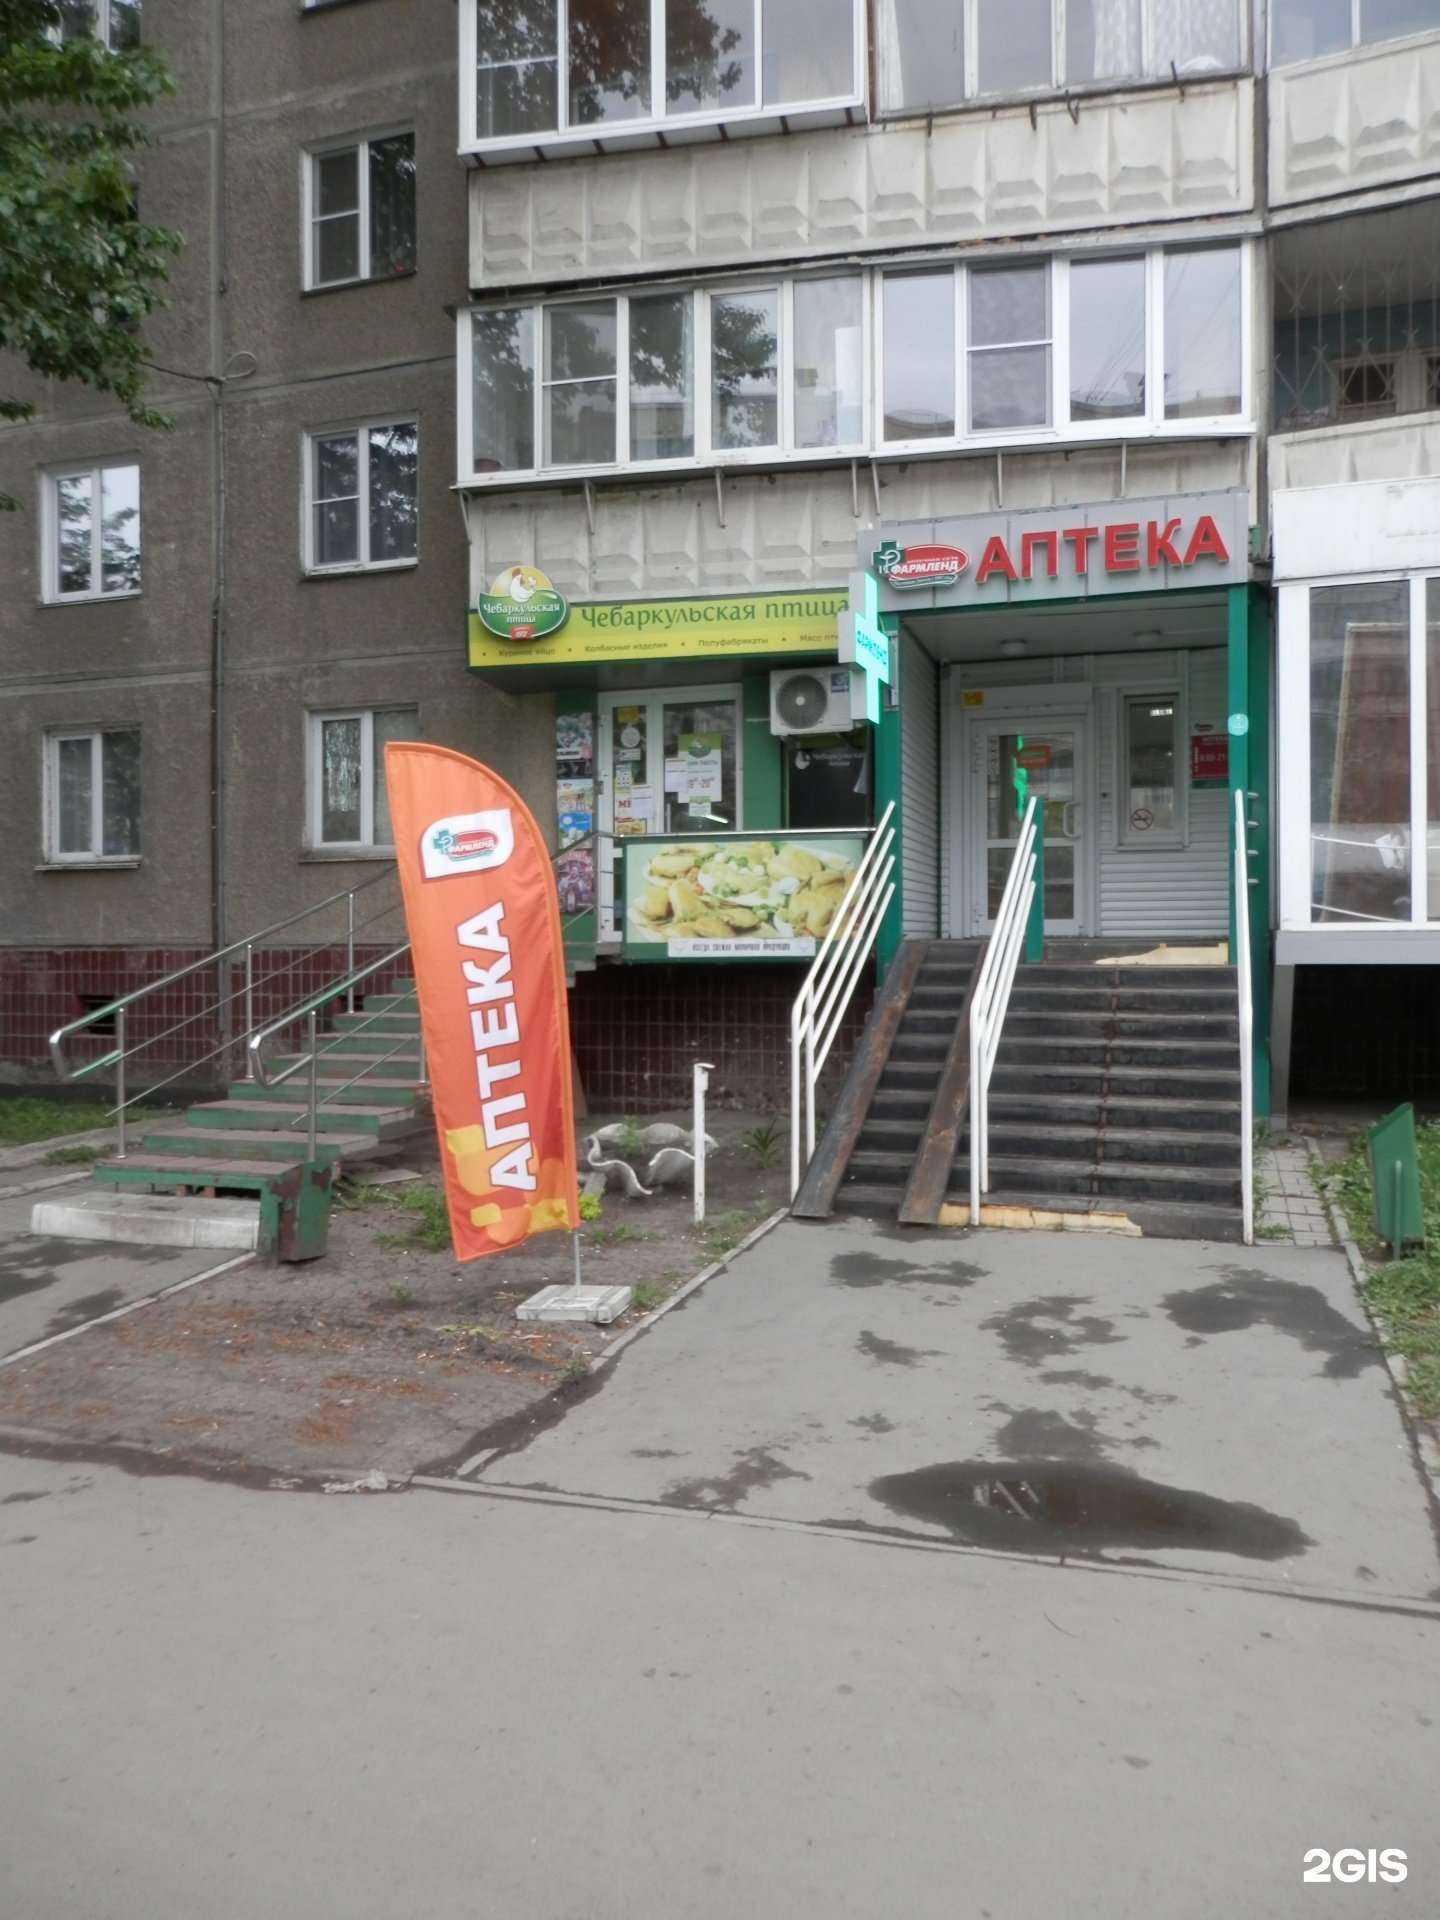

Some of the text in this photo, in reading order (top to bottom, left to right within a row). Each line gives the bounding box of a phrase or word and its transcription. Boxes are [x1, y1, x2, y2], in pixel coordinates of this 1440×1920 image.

[975, 515, 1229, 584] АПТЕКА
[891, 560, 959, 575] ФАРМЛЕНД
[483, 602, 560, 615] Чебаркульская
[582, 599, 850, 631] Чебаркульская птица
[456, 900, 537, 1191] АПТЕКА
